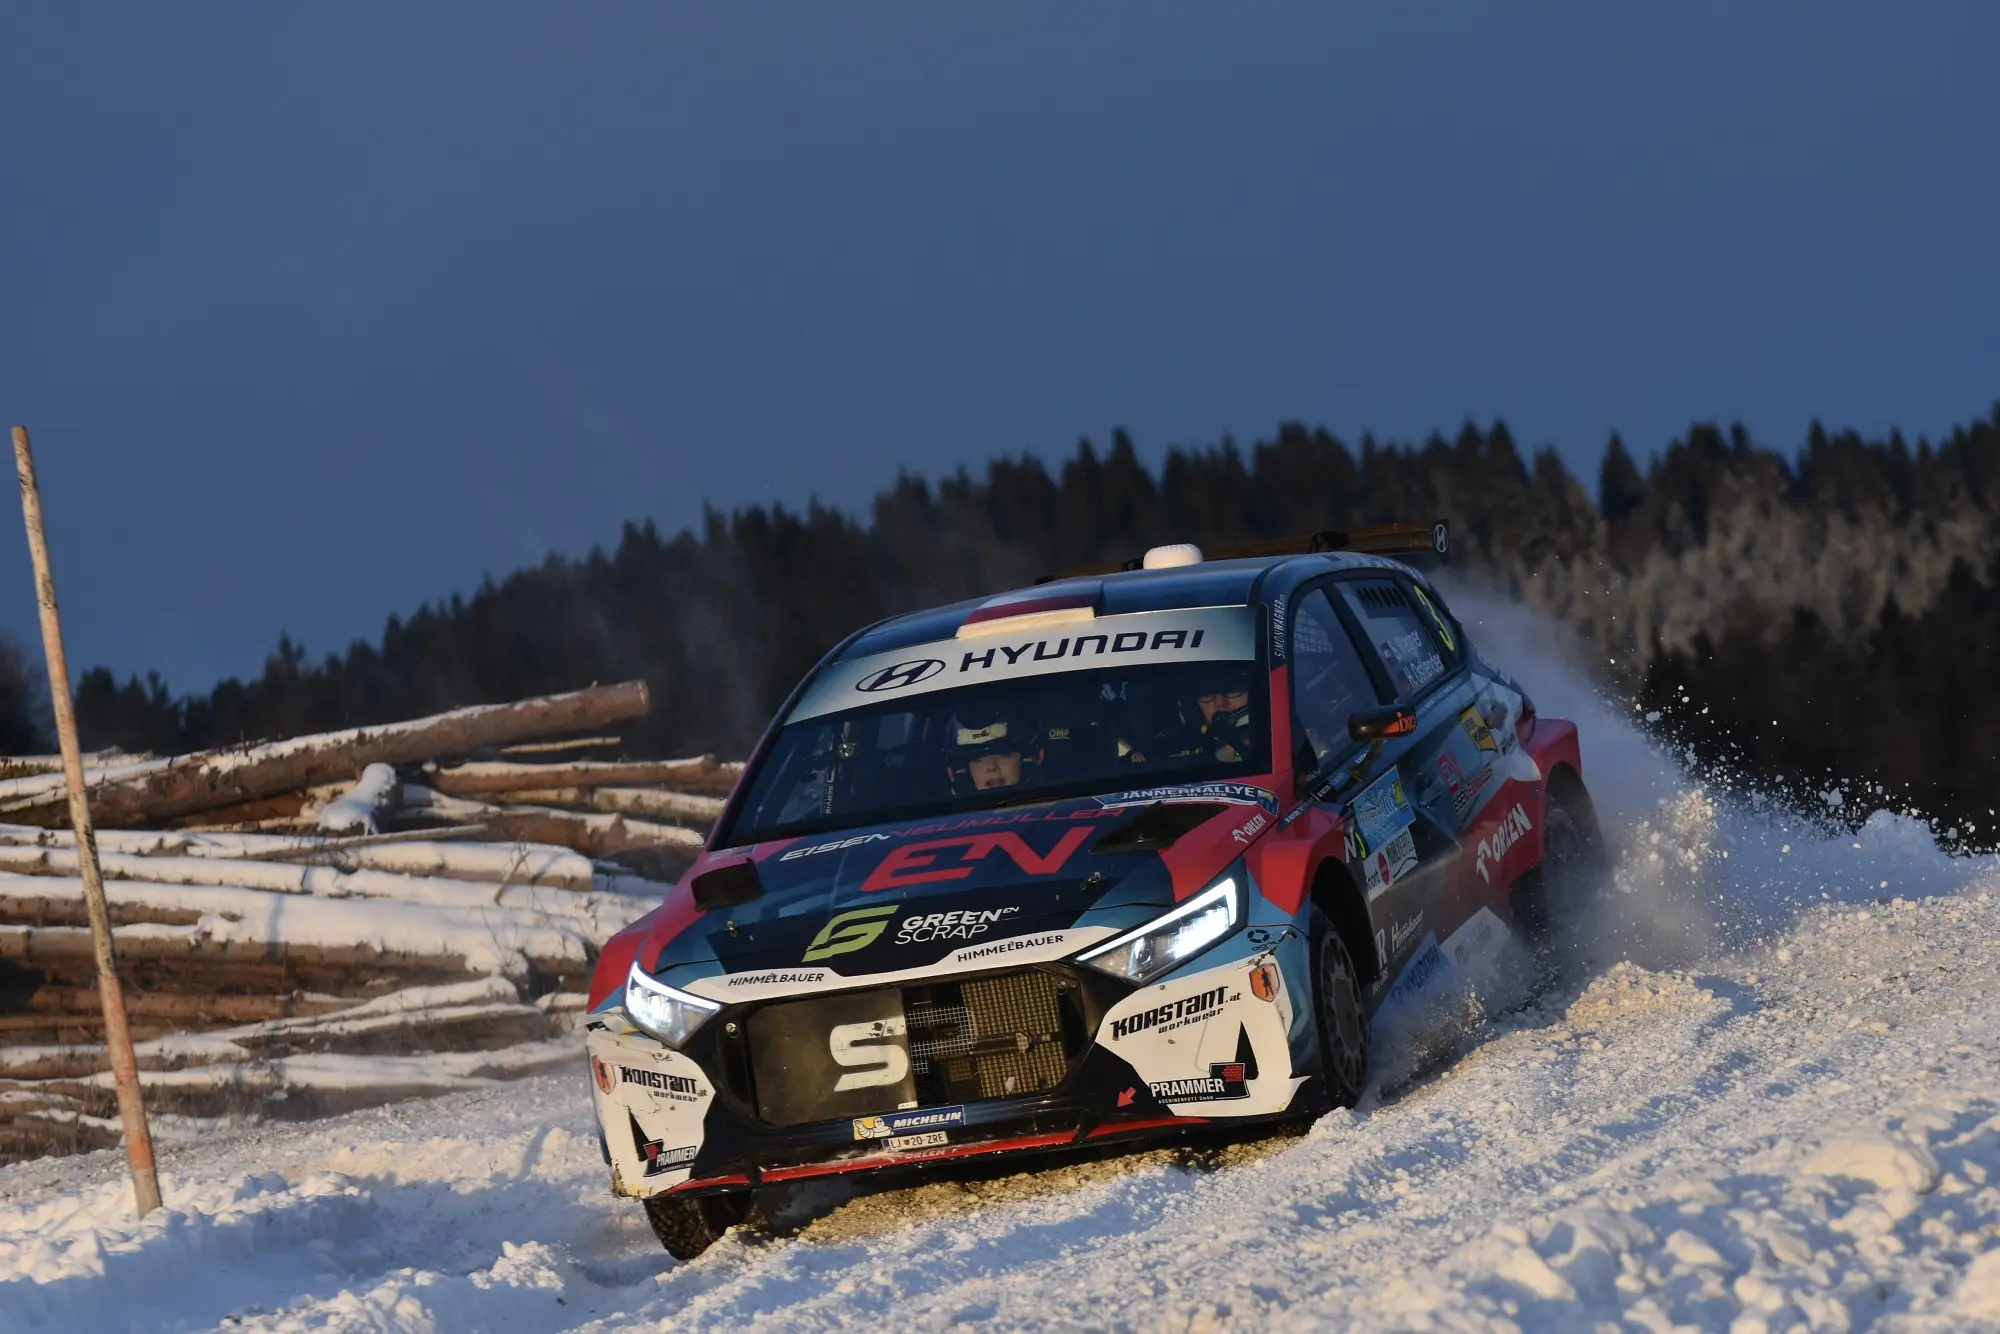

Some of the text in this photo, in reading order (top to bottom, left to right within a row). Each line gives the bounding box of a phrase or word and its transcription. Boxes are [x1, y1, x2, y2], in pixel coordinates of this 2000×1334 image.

[1413, 585, 1455, 651] 3
[959, 629, 1204, 672] HYUNDAI
[1048, 728, 1071, 738] OMP
[1120, 785, 1256, 800] JÄNNERRALLYE
[1242, 812, 1266, 836] ORLEN
[1492, 802, 1533, 863] ORLEN
[860, 825, 1096, 893] EN
[902, 908, 1003, 930] GREEN
[895, 924, 988, 945] SCRAP
[956, 934, 1065, 963] HIMMELBAUER
[728, 972, 825, 987] HIMMELBAUER
[1158, 1007, 1224, 1034] workwear
[829, 1016, 909, 1092] S
[653, 1090, 698, 1103] workwear
[1150, 1078, 1226, 1098] PRAMMER
[892, 1111, 961, 1128] MICHELIN
[890, 1138, 900, 1149] LJ
[904, 1148, 945, 1159] ORLEN
[656, 1147, 696, 1168] PRAMMER
